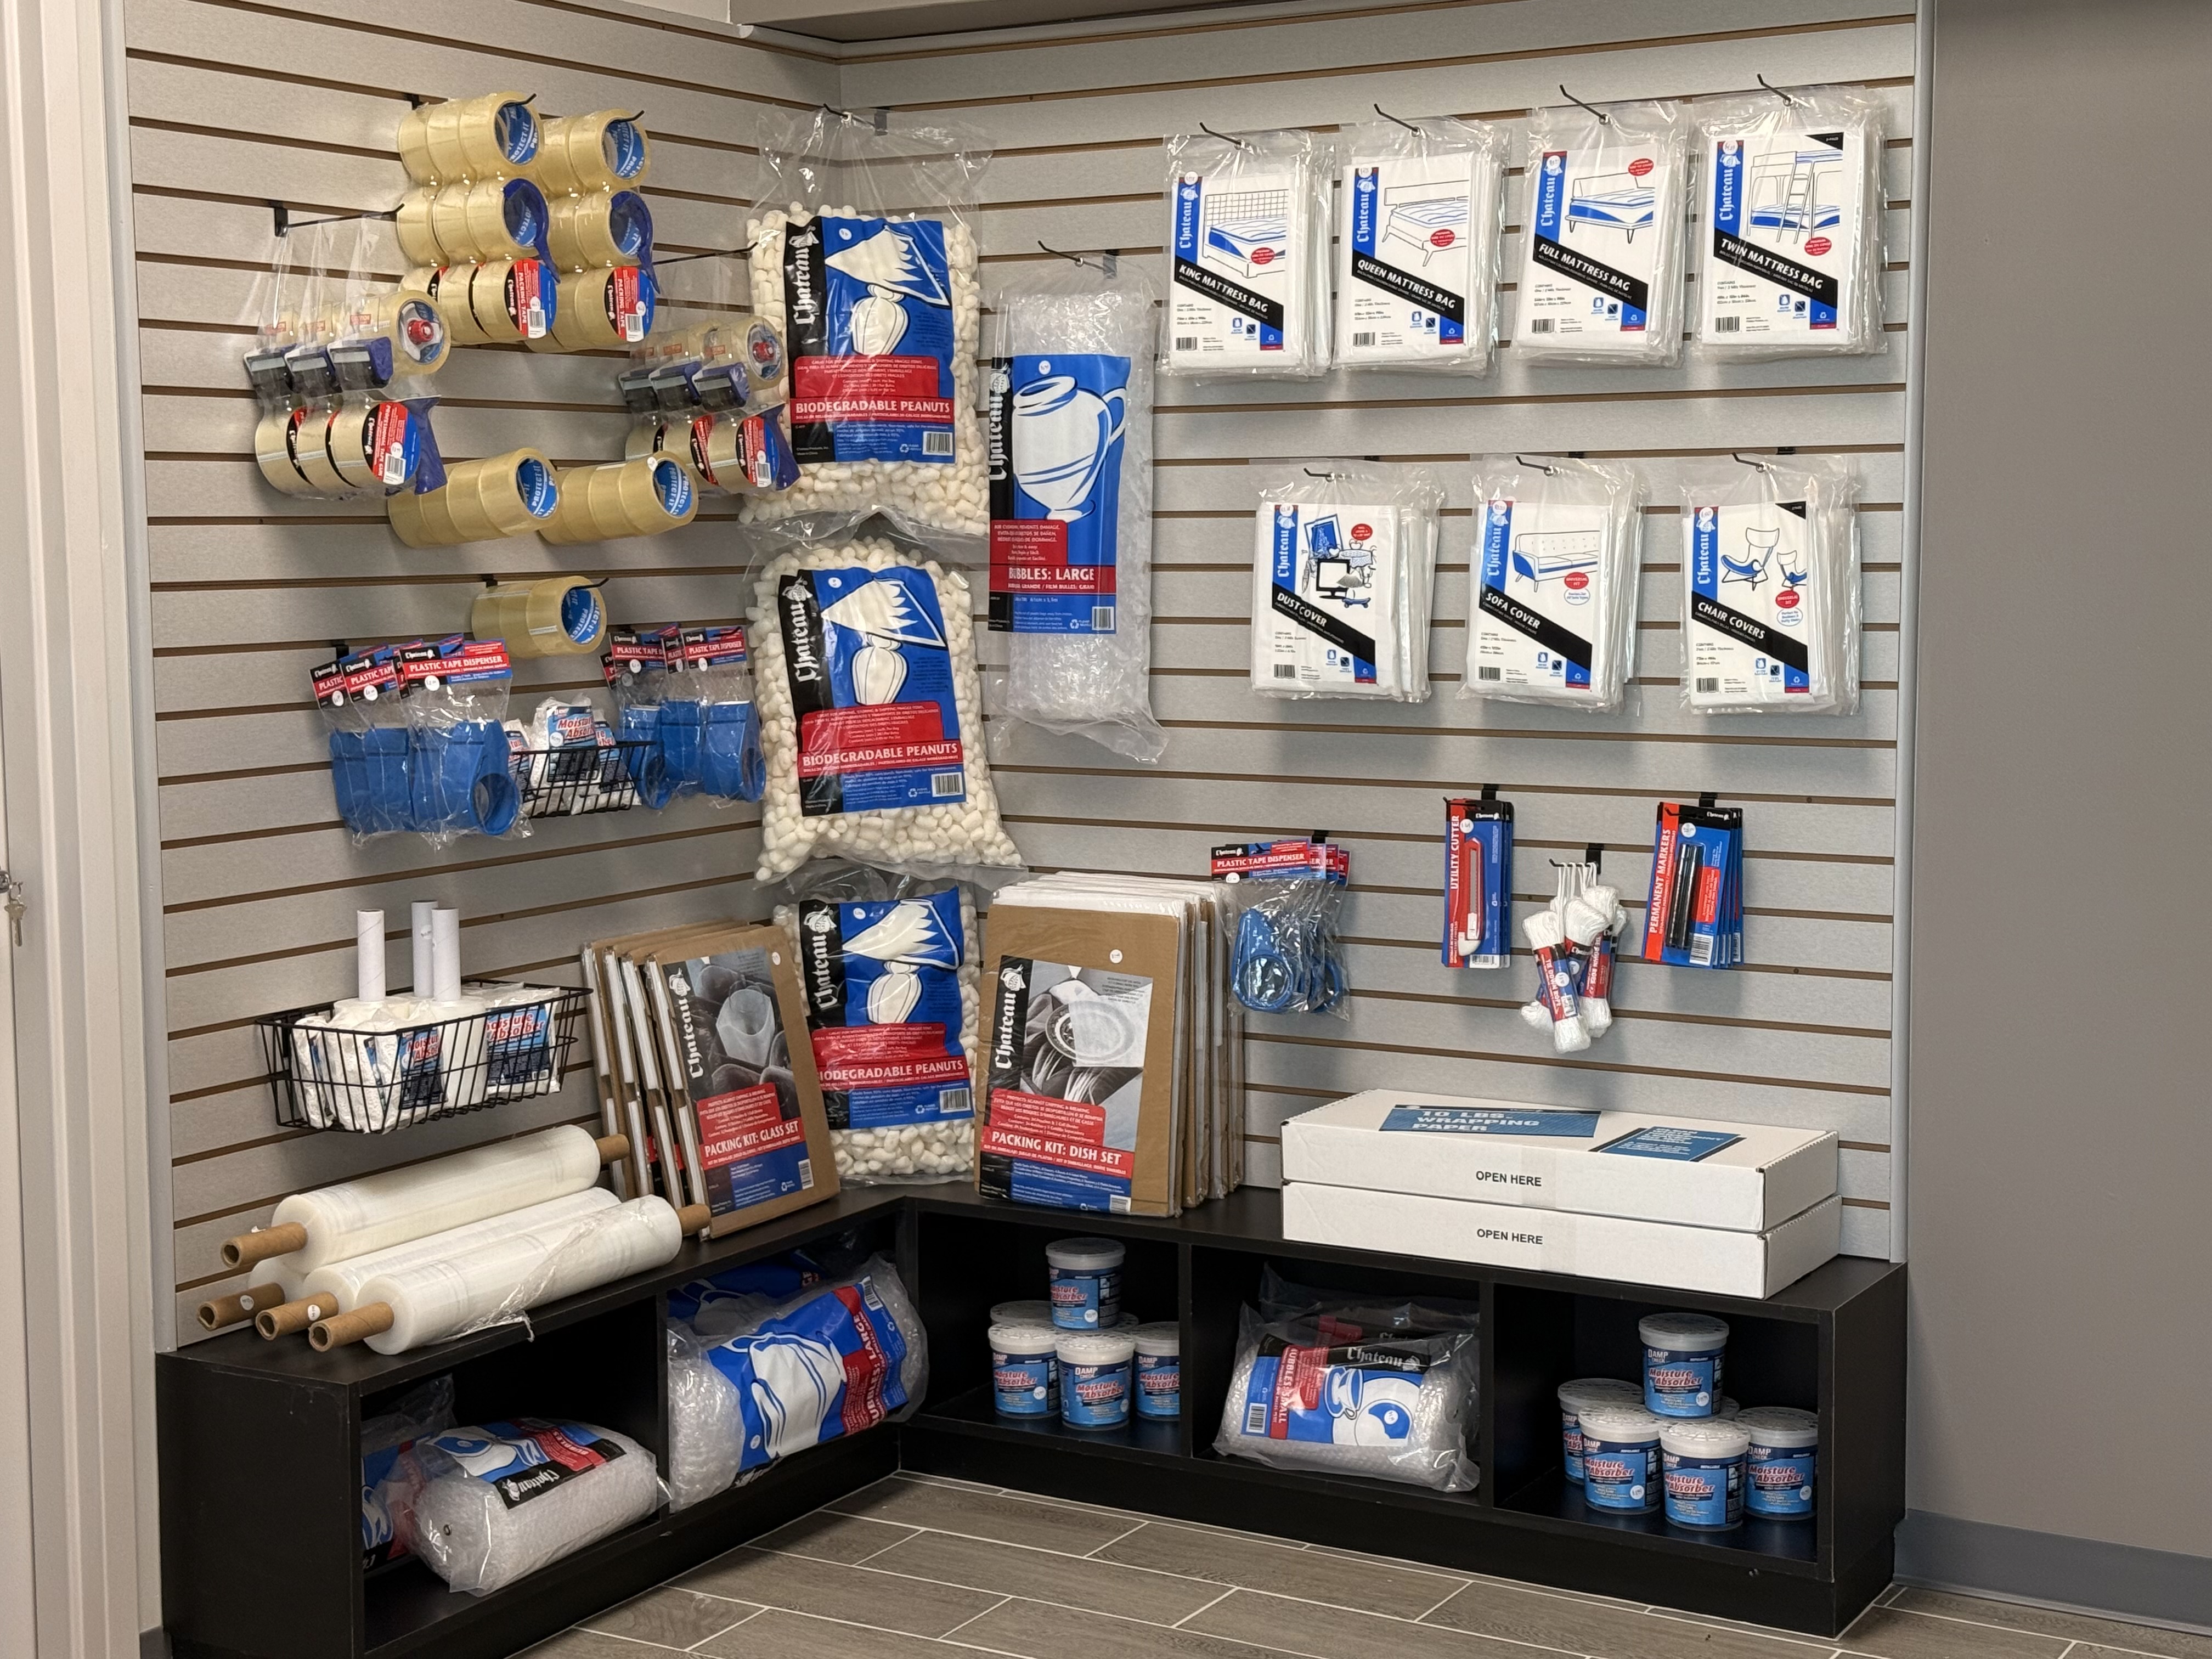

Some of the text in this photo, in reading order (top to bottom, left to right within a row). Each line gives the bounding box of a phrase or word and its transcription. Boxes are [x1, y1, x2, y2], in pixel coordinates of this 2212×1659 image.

[509, 122, 529, 161] ROTECT-IT
[1541, 177, 1554, 227] Chateau
[1719, 168, 1734, 221] Chateau
[1180, 201, 1192, 249] Chateau
[1358, 194, 1369, 242] Chateau
[1539, 244, 1630, 291] FULL MATTRESS BAG
[1721, 239, 1823, 289] TWIN MATTRESS BAG
[793, 248, 815, 325] Chateau
[1179, 264, 1268, 312] KING MATTRESS BAG
[1358, 259, 1387, 278] QUEEN
[1387, 272, 1435, 298] MATTRESS
[1435, 294, 1455, 308] BAG
[796, 400, 950, 414] BIODEGRADABLE PEANUTS
[989, 396, 1008, 481] Chateau
[532, 464, 542, 507] PROTECT-IT
[1277, 529, 1290, 578] Chateau
[1487, 527, 1502, 577] Chateau
[1697, 534, 1709, 585] Chateau
[1056, 568, 1094, 580] LARGE
[1277, 592, 1300, 610] DUST
[1299, 607, 1327, 627] COVER
[1486, 592, 1508, 611] SOFA
[1510, 607, 1541, 629] COVER
[1698, 602, 1728, 622] CHAIR
[1729, 617, 1765, 639] COVERS
[570, 608, 588, 639] PROTECT
[689, 645, 707, 654] PLASTIC
[791, 602, 821, 682] Chateau
[409, 656, 503, 672] PLASTIC TAPE DISPENSER
[319, 675, 343, 691] PLASTIC
[351, 670, 377, 685] PLASTIC
[803, 743, 957, 767] BIODEGRADABLE PEANUTS
[1217, 859, 1247, 867] PLASTIC
[1267, 853, 1304, 863] DISPENSER
[1451, 815, 1460, 889] UTILITY CUTTER
[1649, 875, 1664, 933] PERMANENT
[1657, 828, 1671, 874] MARKERS
[812, 934, 838, 1009] Chateau
[1553, 989, 1562, 1007] ROPE
[678, 997, 704, 1079] Chateau
[995, 992, 1017, 1069] Chateau
[818, 1060, 963, 1081] IODEGRADABLE PEANUTS
[1412, 1123, 1487, 1131] PAPER
[1417, 1117, 1539, 1126] WRAPPING
[705, 1137, 742, 1158] PACKING
[743, 1132, 759, 1147] KIT:
[760, 1125, 785, 1141] GLASS
[786, 1121, 799, 1135] SET
[991, 1131, 1041, 1150] PACKING
[1045, 1141, 1066, 1155] KIT:
[1070, 1146, 1098, 1161] DISH
[1101, 1152, 1122, 1165] SET
[1476, 1171, 1542, 1187] OPEN HERE
[1477, 1229, 1543, 1245] OPEN HERE
[1347, 1347, 1403, 1367] Chateau
[1648, 1349, 1668, 1358] DAMP
[853, 1315, 881, 1427] UBBLES: LARGE
[1075, 1367, 1098, 1375] DAMP
[1649, 1368, 1692, 1378] Moisture
[1655, 1377, 1702, 1385] Absorber
[1077, 1381, 1118, 1391] Moisture
[1584, 1438, 1600, 1448] DAMP
[1748, 1447, 1771, 1455] DAMP
[1585, 1458, 1624, 1468] Moisture
[1664, 1453, 1680, 1463] DAMP
[1750, 1465, 1796, 1474] Moisture
[520, 1469, 560, 1492] Chateau
[1590, 1468, 1634, 1476] Absorber
[1666, 1474, 1703, 1484] Moisture
[1757, 1474, 1804, 1482] Absorber
[1669, 1483, 1714, 1492] Absorber
